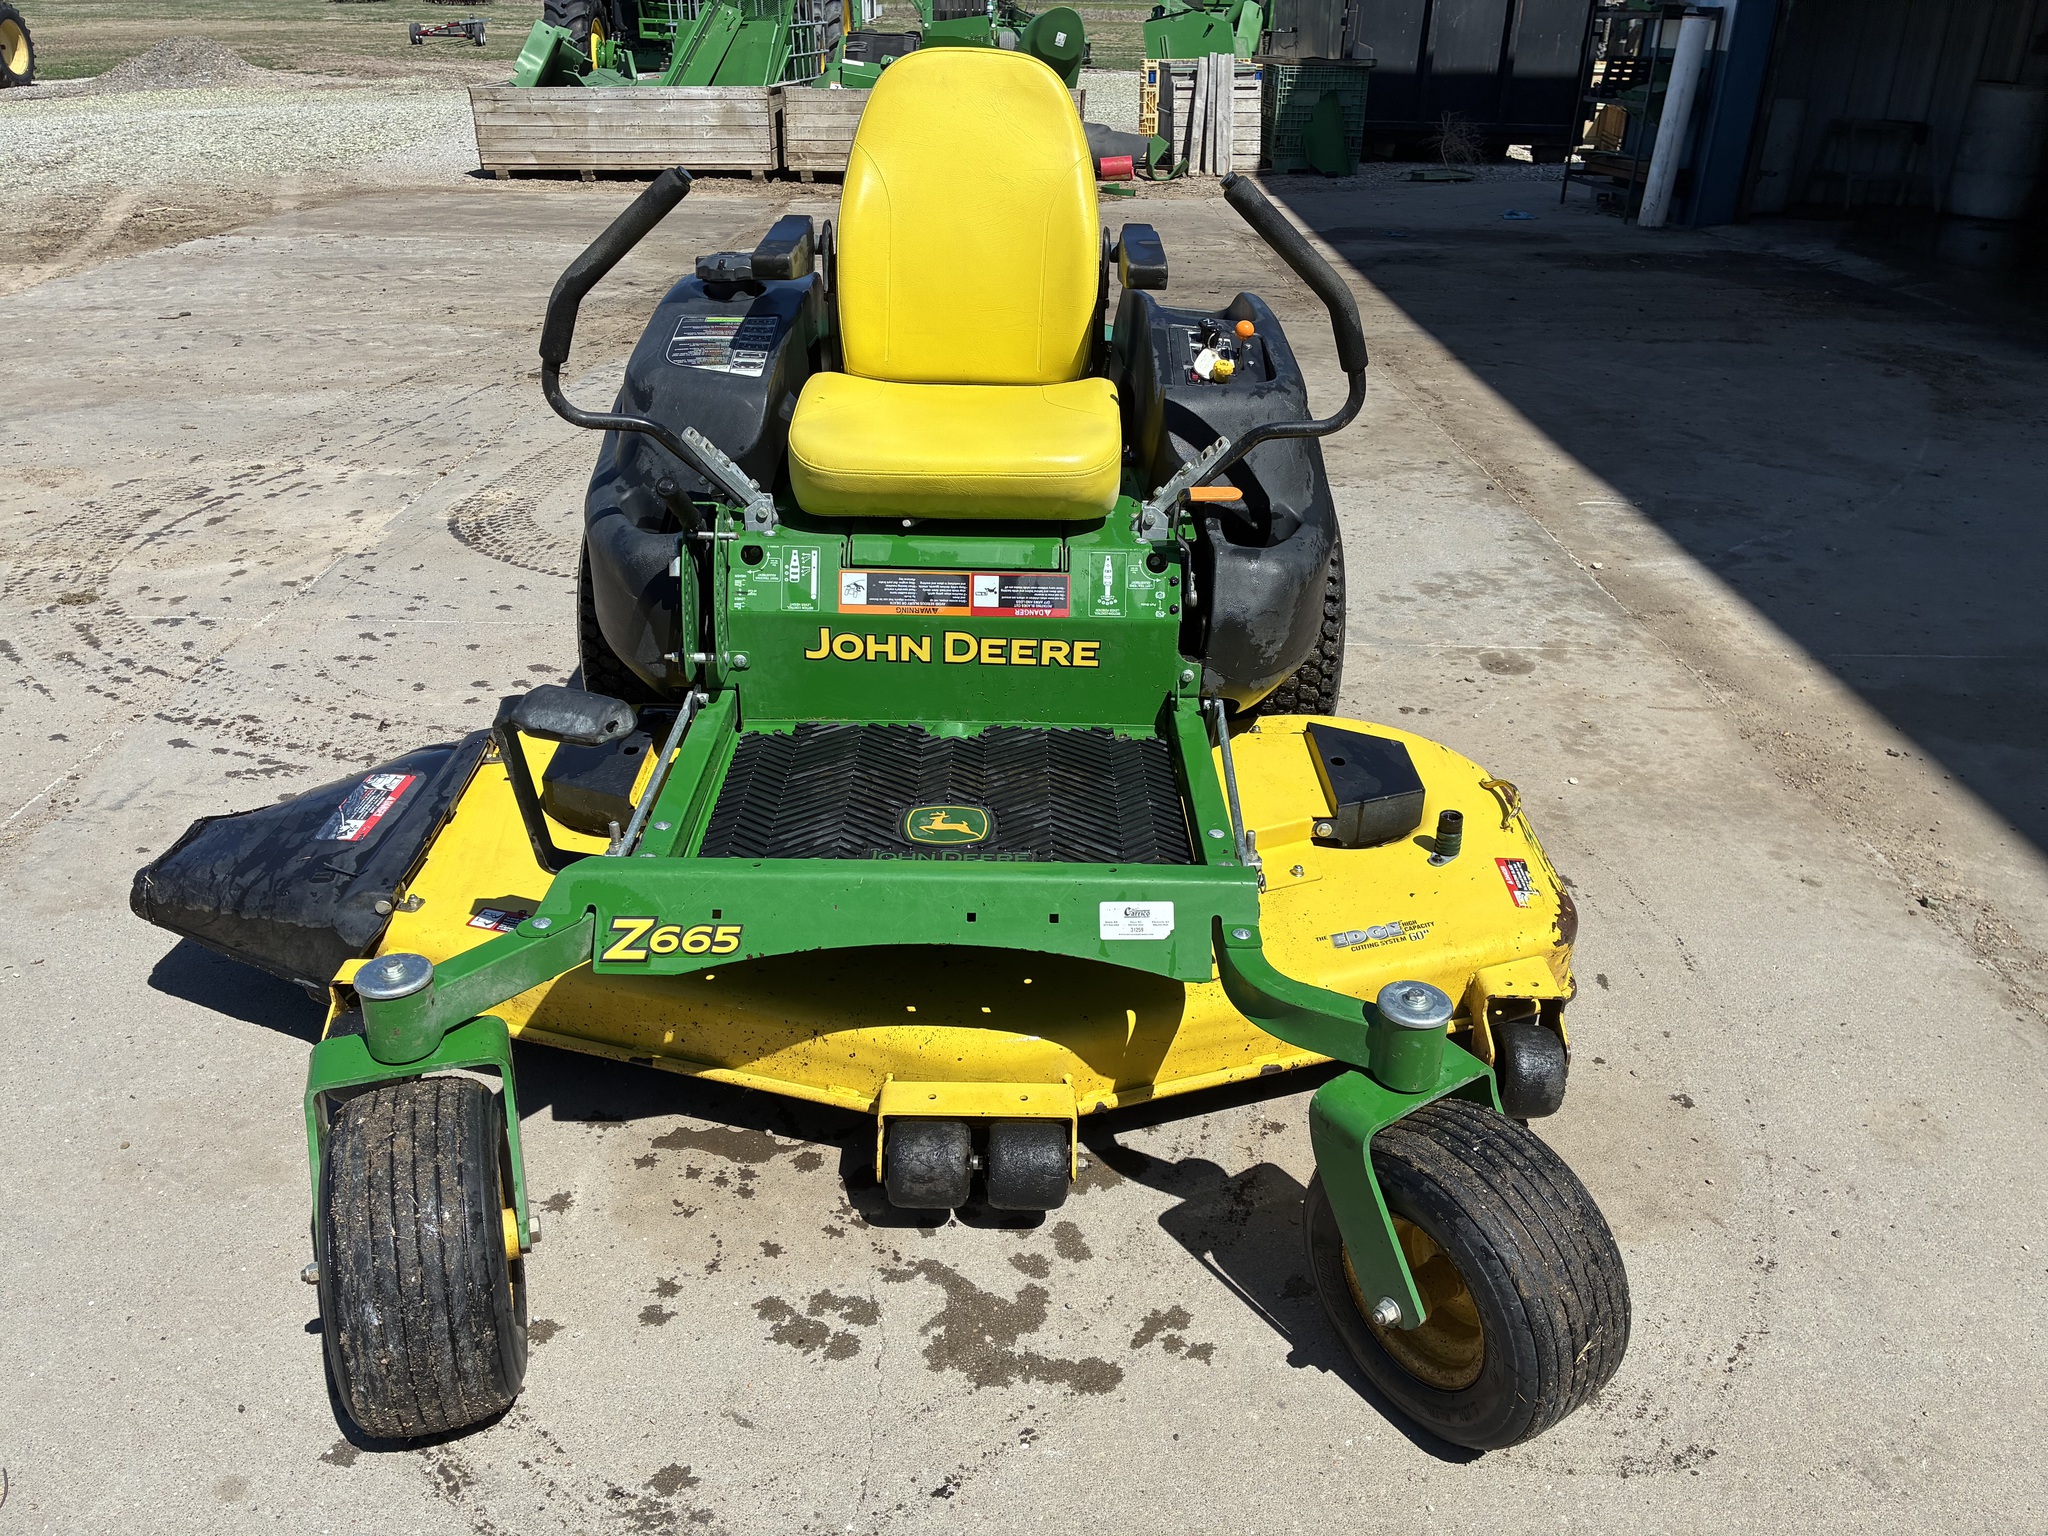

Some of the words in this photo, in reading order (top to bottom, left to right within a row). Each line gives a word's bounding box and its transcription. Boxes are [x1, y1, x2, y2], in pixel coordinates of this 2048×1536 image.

[804, 627, 932, 663] JOHN
[942, 630, 1101, 668] DEERE
[599, 916, 744, 962] Z665
[1331, 921, 1404, 948] EDGE
[1404, 921, 1435, 932] CAPACITY
[1351, 942, 1380, 952] CUTTING
[1381, 936, 1407, 946] SYSTEM
[1409, 929, 1430, 942] 60"
